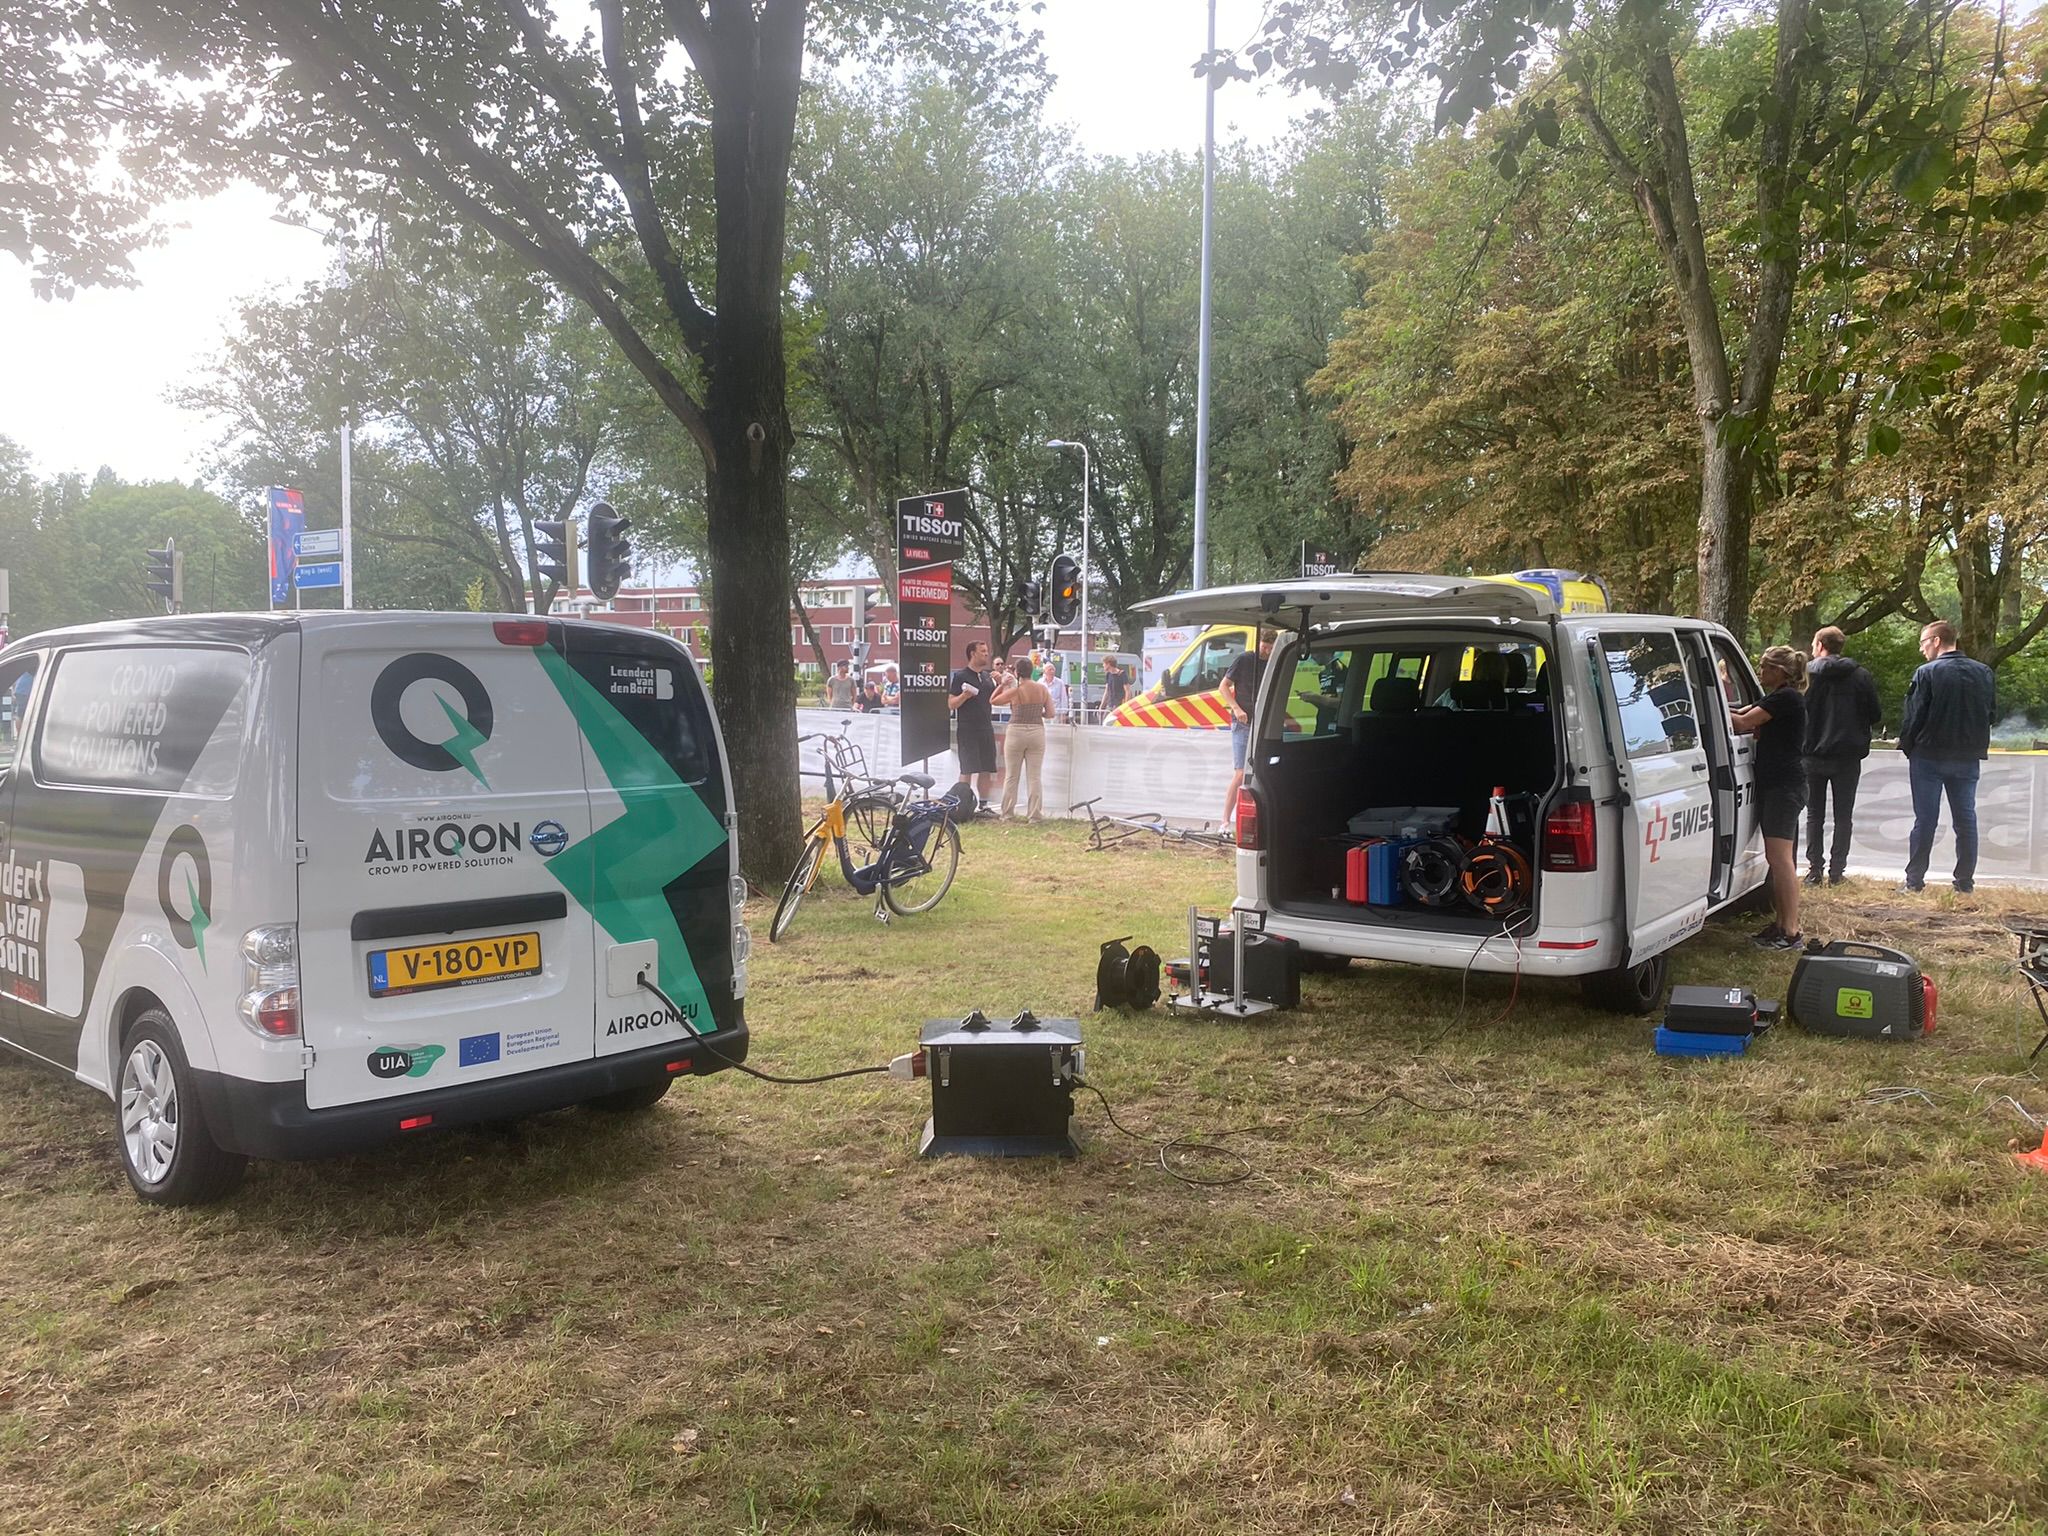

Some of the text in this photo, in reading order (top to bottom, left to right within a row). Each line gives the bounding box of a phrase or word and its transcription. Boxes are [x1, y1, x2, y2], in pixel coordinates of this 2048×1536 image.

[903, 514, 962, 537] TISSOT
[1305, 564, 1335, 576] TISSOT
[901, 585, 949, 600] INTERMEDIO
[903, 628, 948, 642] TISSOT
[610, 665, 654, 678] Leendert
[111, 664, 176, 697] CROWD
[636, 678, 654, 687] van
[903, 674, 948, 687] TISSOT
[86, 701, 168, 736] POWERED
[67, 735, 161, 776] SOLUTIONS
[364, 822, 521, 863] AIRQON
[368, 856, 514, 876] CROWD POWERED SOLUTION
[0, 848, 44, 902] dert
[5, 900, 42, 943] van
[402, 940, 529, 980] V-180-VP
[373, 974, 387, 984] NL
[506, 1027, 553, 1041] European Union
[506, 1031, 560, 1048] European Regional
[506, 1039, 560, 1056] Development Fund
[380, 1054, 406, 1070] UIA
